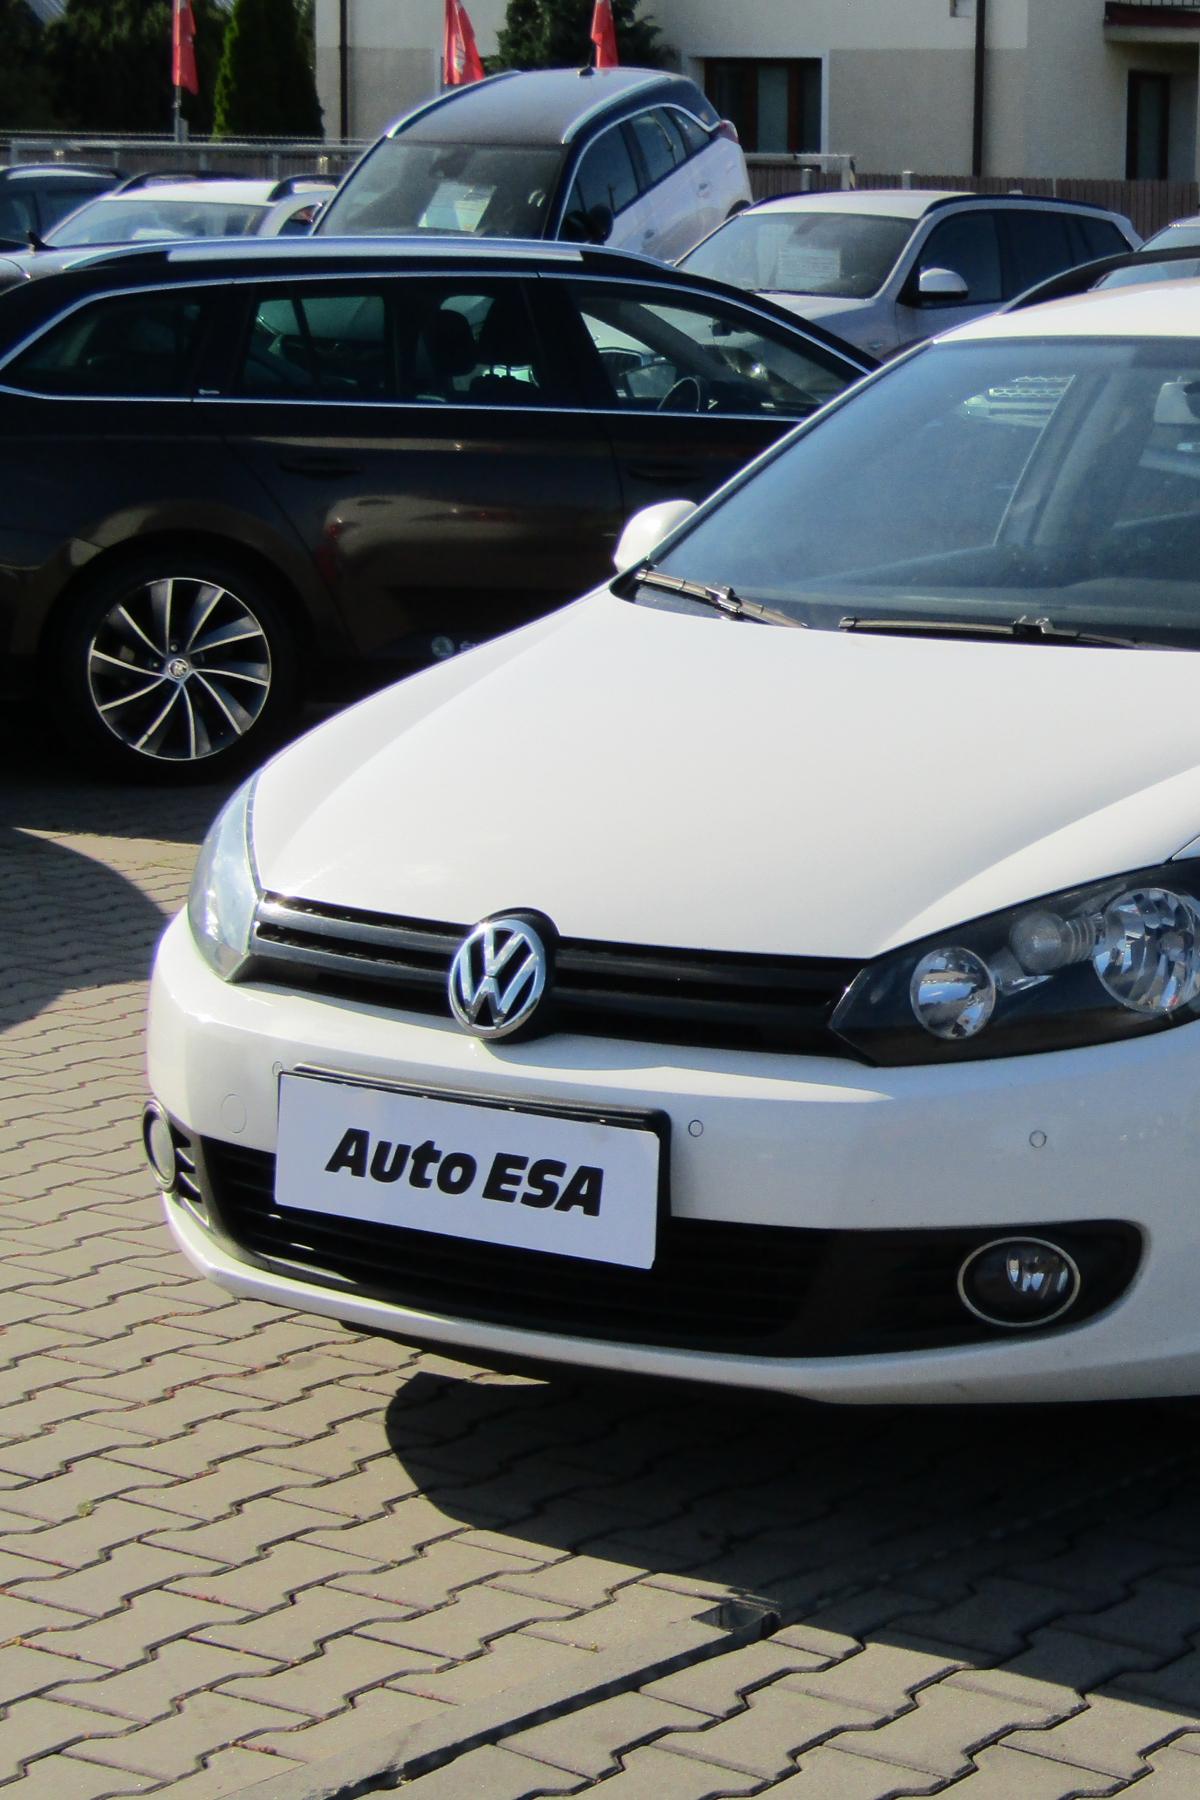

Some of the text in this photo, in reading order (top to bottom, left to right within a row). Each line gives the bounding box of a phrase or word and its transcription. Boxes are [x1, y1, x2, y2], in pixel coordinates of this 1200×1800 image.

[452, 921, 542, 1034] VW
[324, 1127, 605, 1217] Auto ESA
